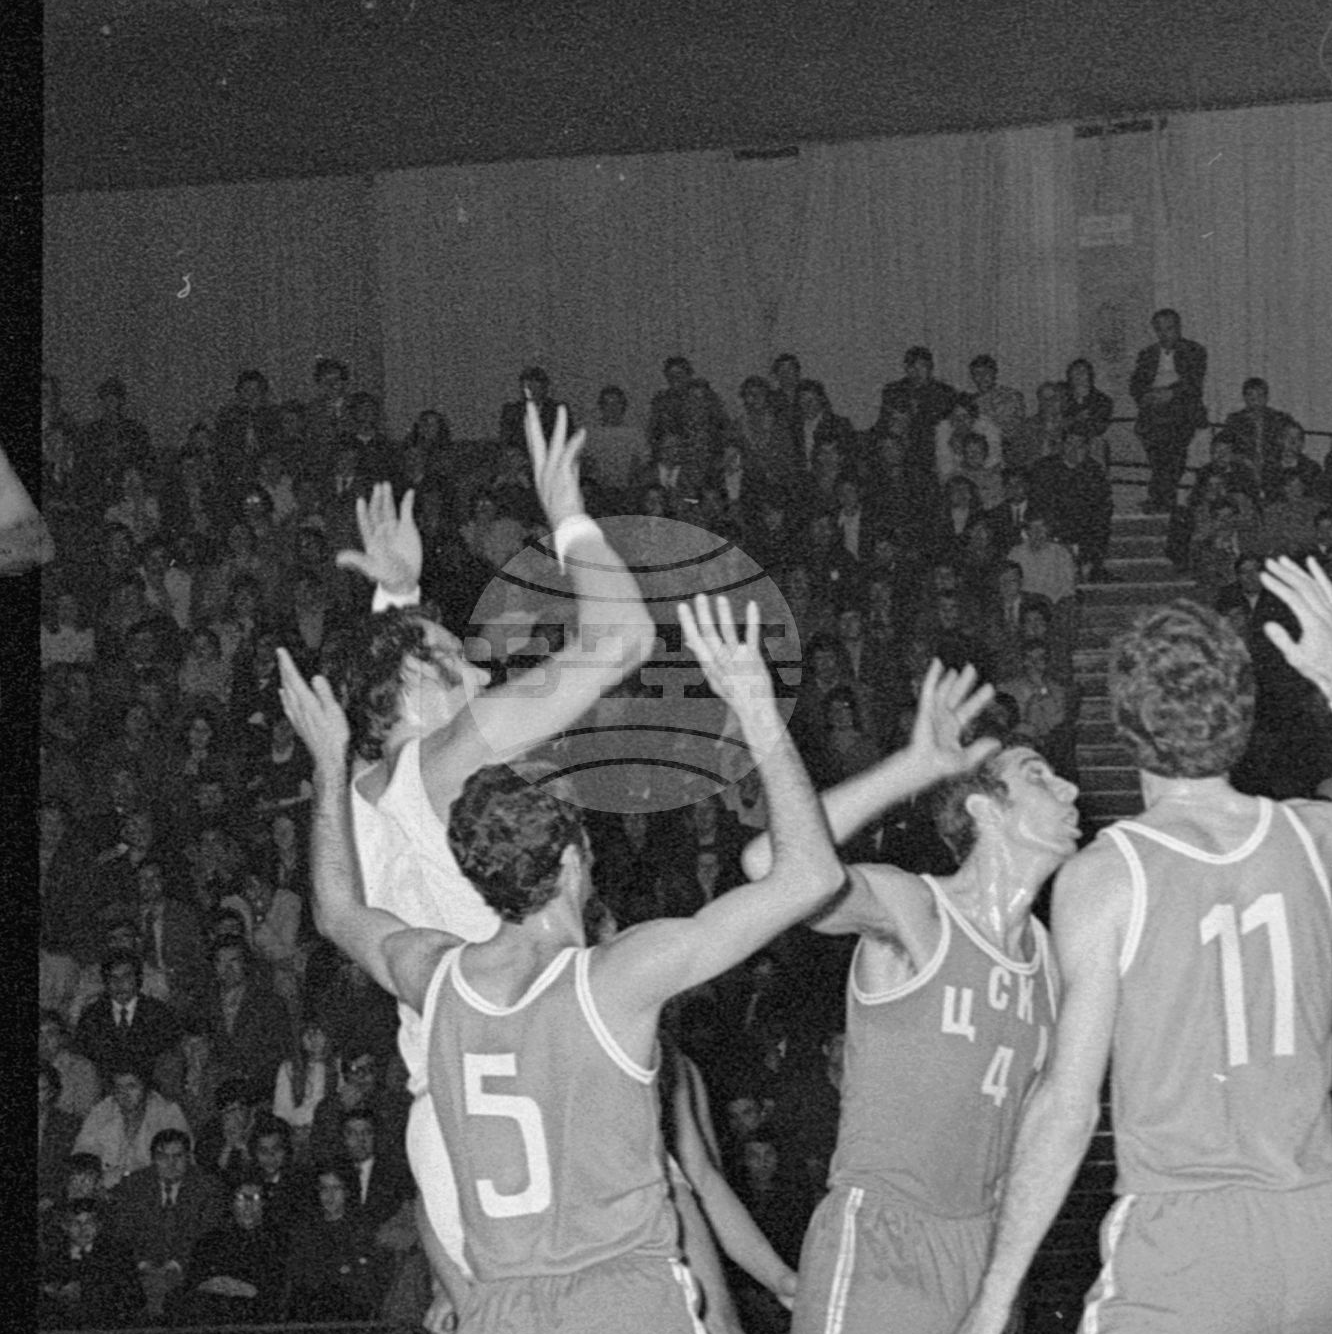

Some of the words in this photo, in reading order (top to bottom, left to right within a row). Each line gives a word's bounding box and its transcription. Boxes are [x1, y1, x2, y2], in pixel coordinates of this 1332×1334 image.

[1200, 893, 1294, 1066] 11
[463, 1052, 552, 1218] 5
[981, 1045, 1014, 1107] 4
